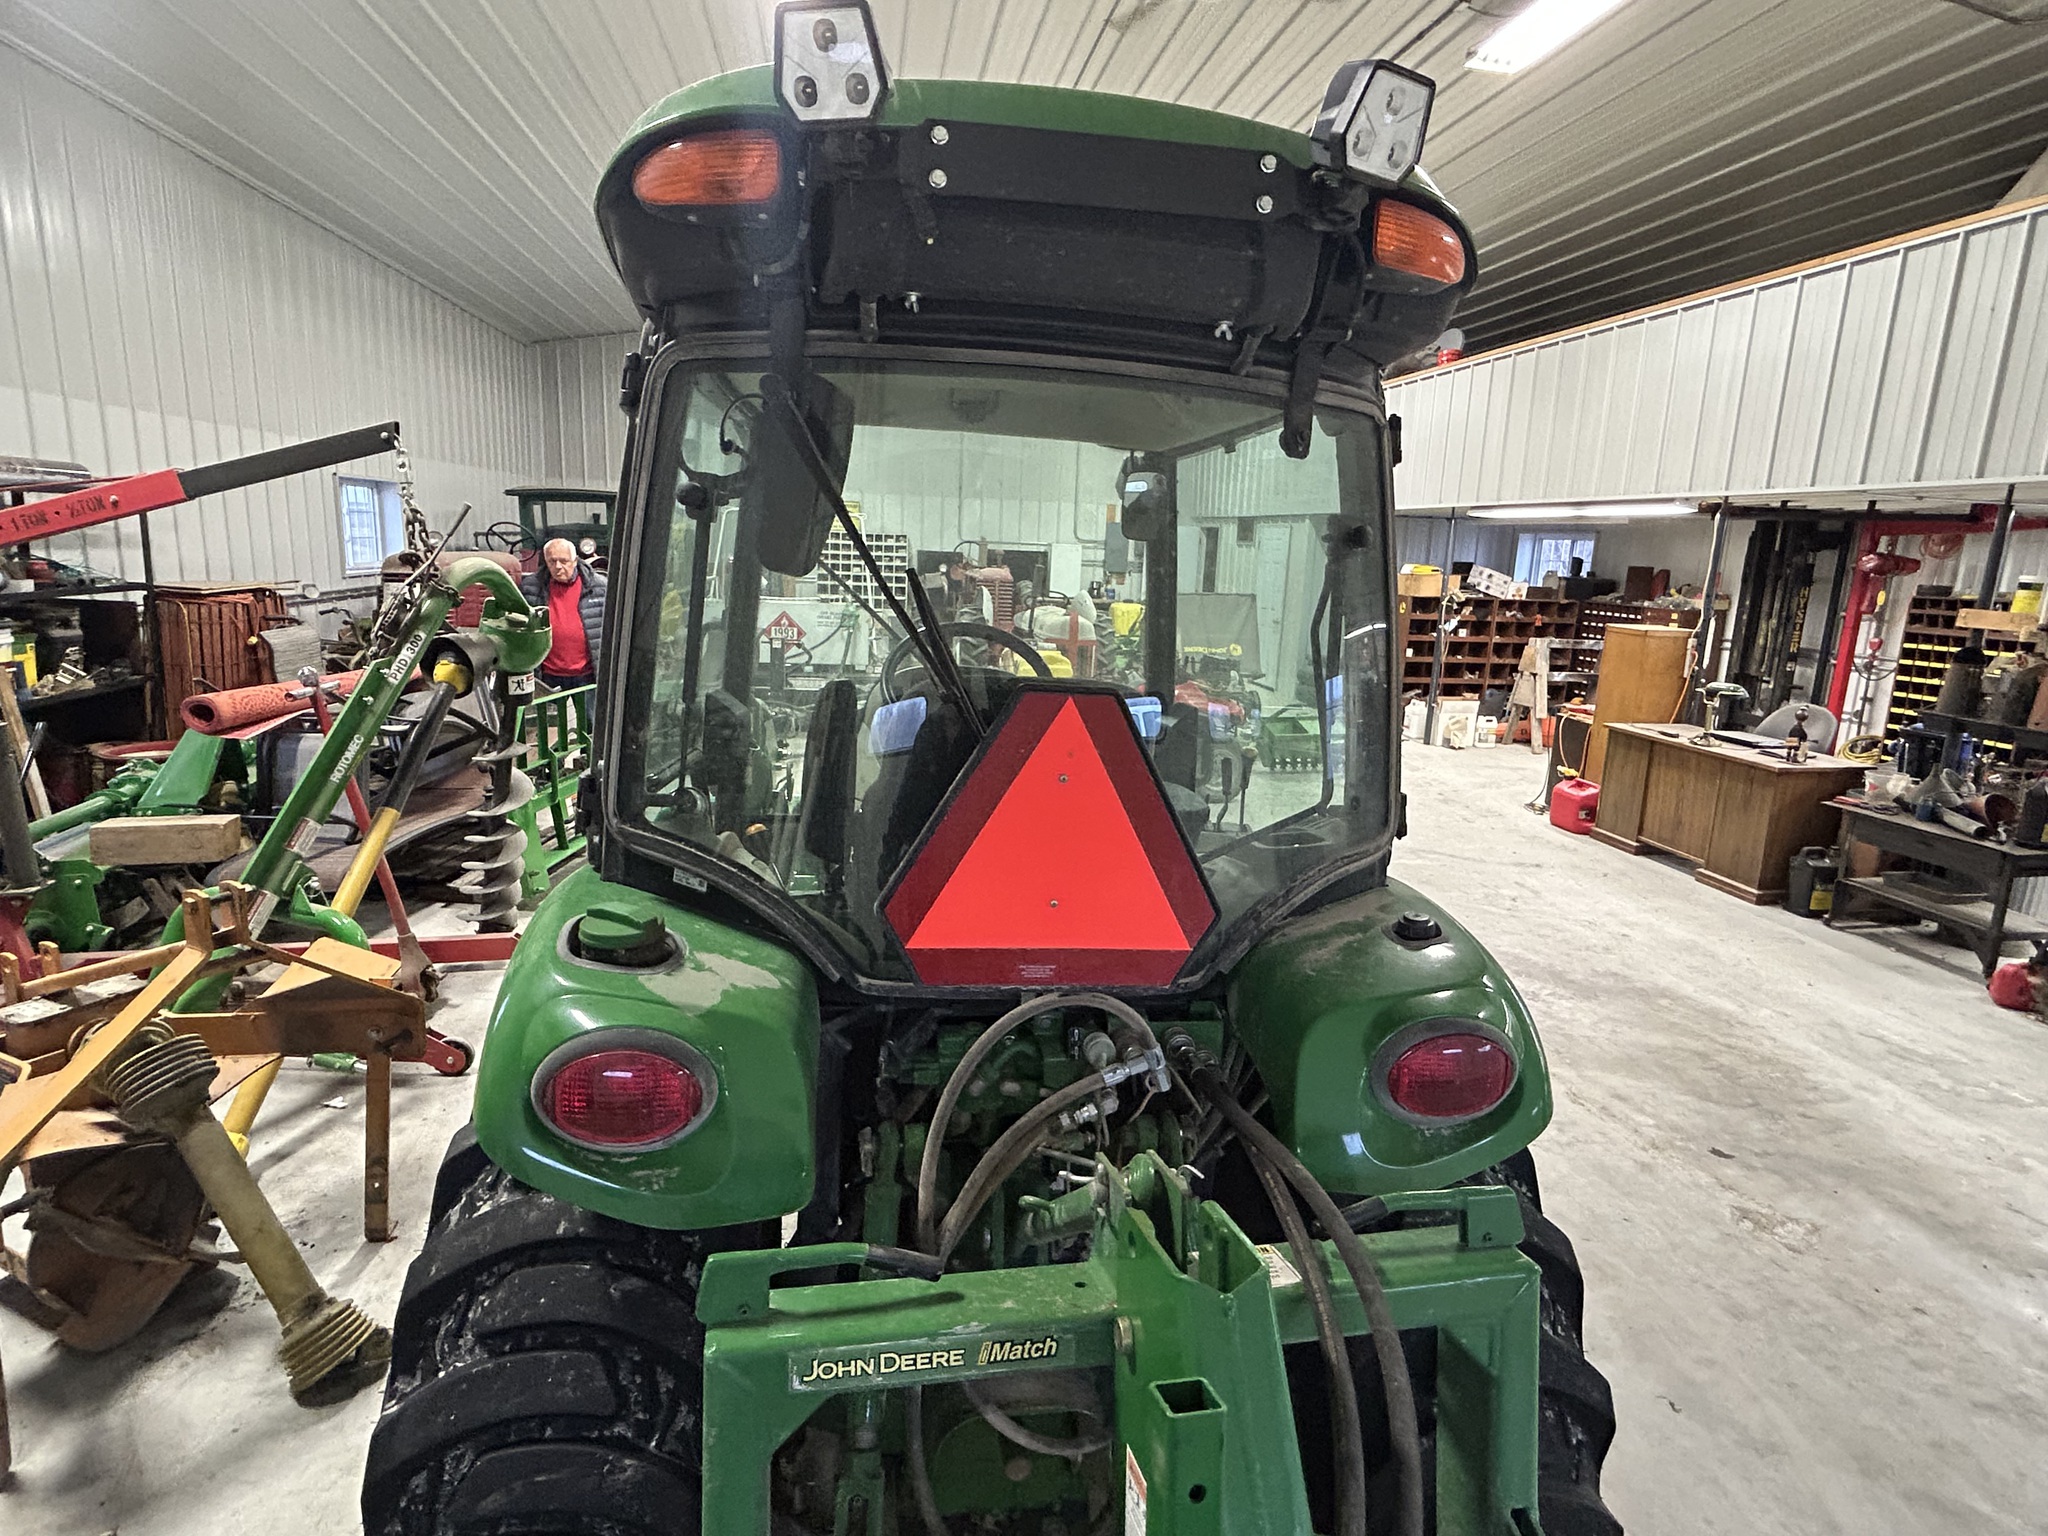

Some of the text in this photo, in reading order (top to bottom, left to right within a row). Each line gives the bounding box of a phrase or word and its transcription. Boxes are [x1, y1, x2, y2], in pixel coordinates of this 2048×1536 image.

[20, 508, 48, 530] TON
[773, 627, 795, 639] 1993
[1789, 586, 1809, 653] HYSTER
[390, 634, 423, 681] PHD 300
[330, 733, 364, 783] ROTOMEC
[803, 1358, 876, 1382] JOHN
[879, 1350, 966, 1374] DEERE
